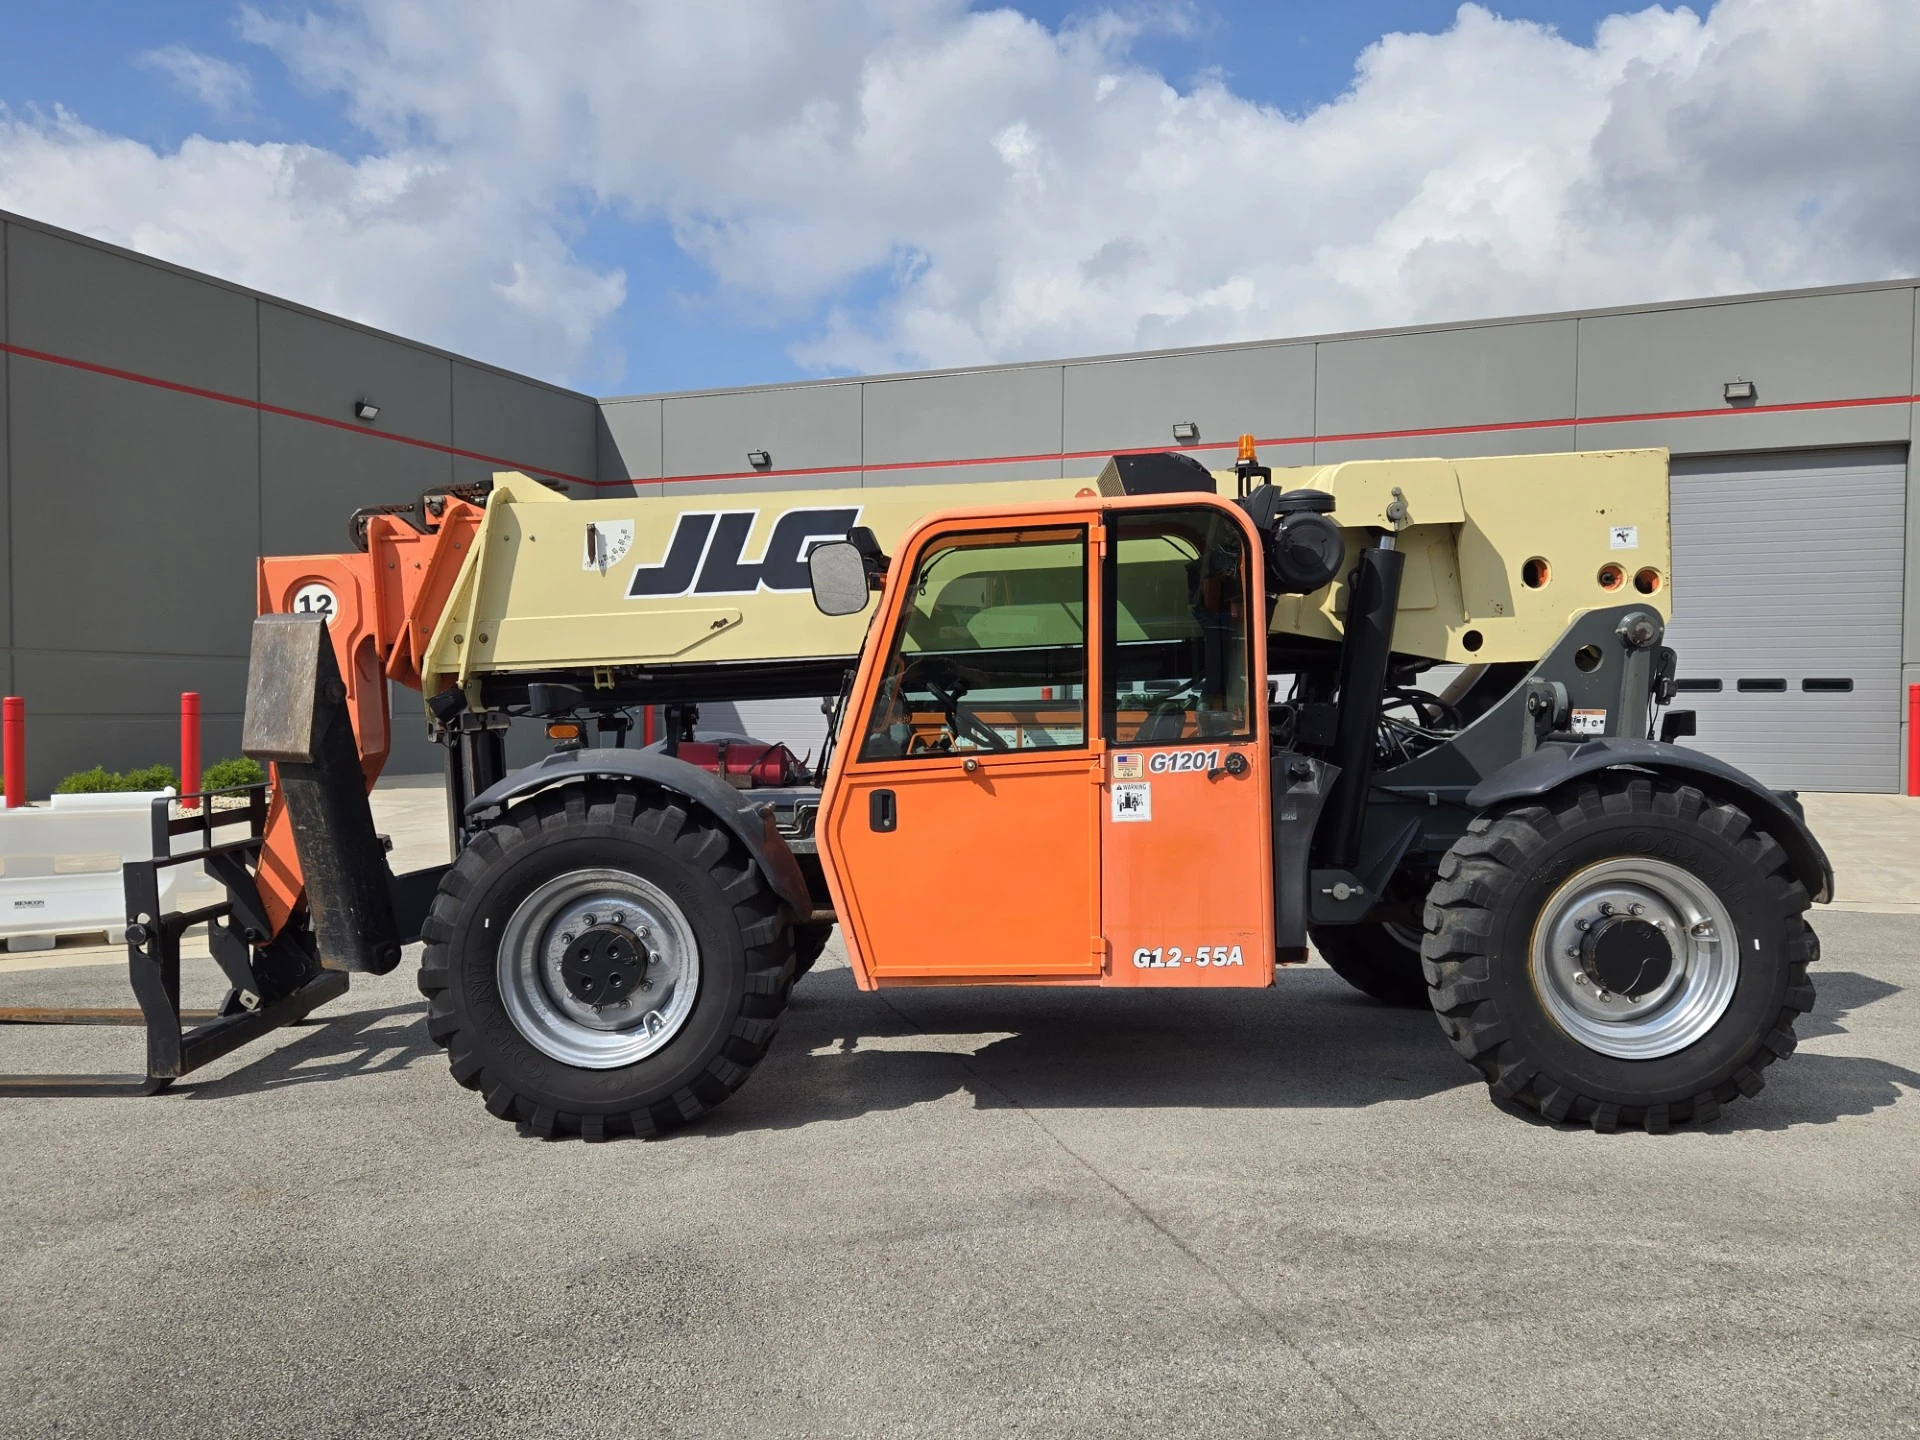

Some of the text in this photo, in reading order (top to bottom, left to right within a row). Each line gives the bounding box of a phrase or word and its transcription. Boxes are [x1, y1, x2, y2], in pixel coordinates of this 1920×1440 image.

[624, 505, 864, 600] JLG
[299, 594, 333, 614] 12
[1149, 750, 1219, 774] G1201
[1123, 783, 1147, 791] WARNING
[1132, 945, 1244, 968] G12-55A
[467, 961, 546, 1078] OTANI
